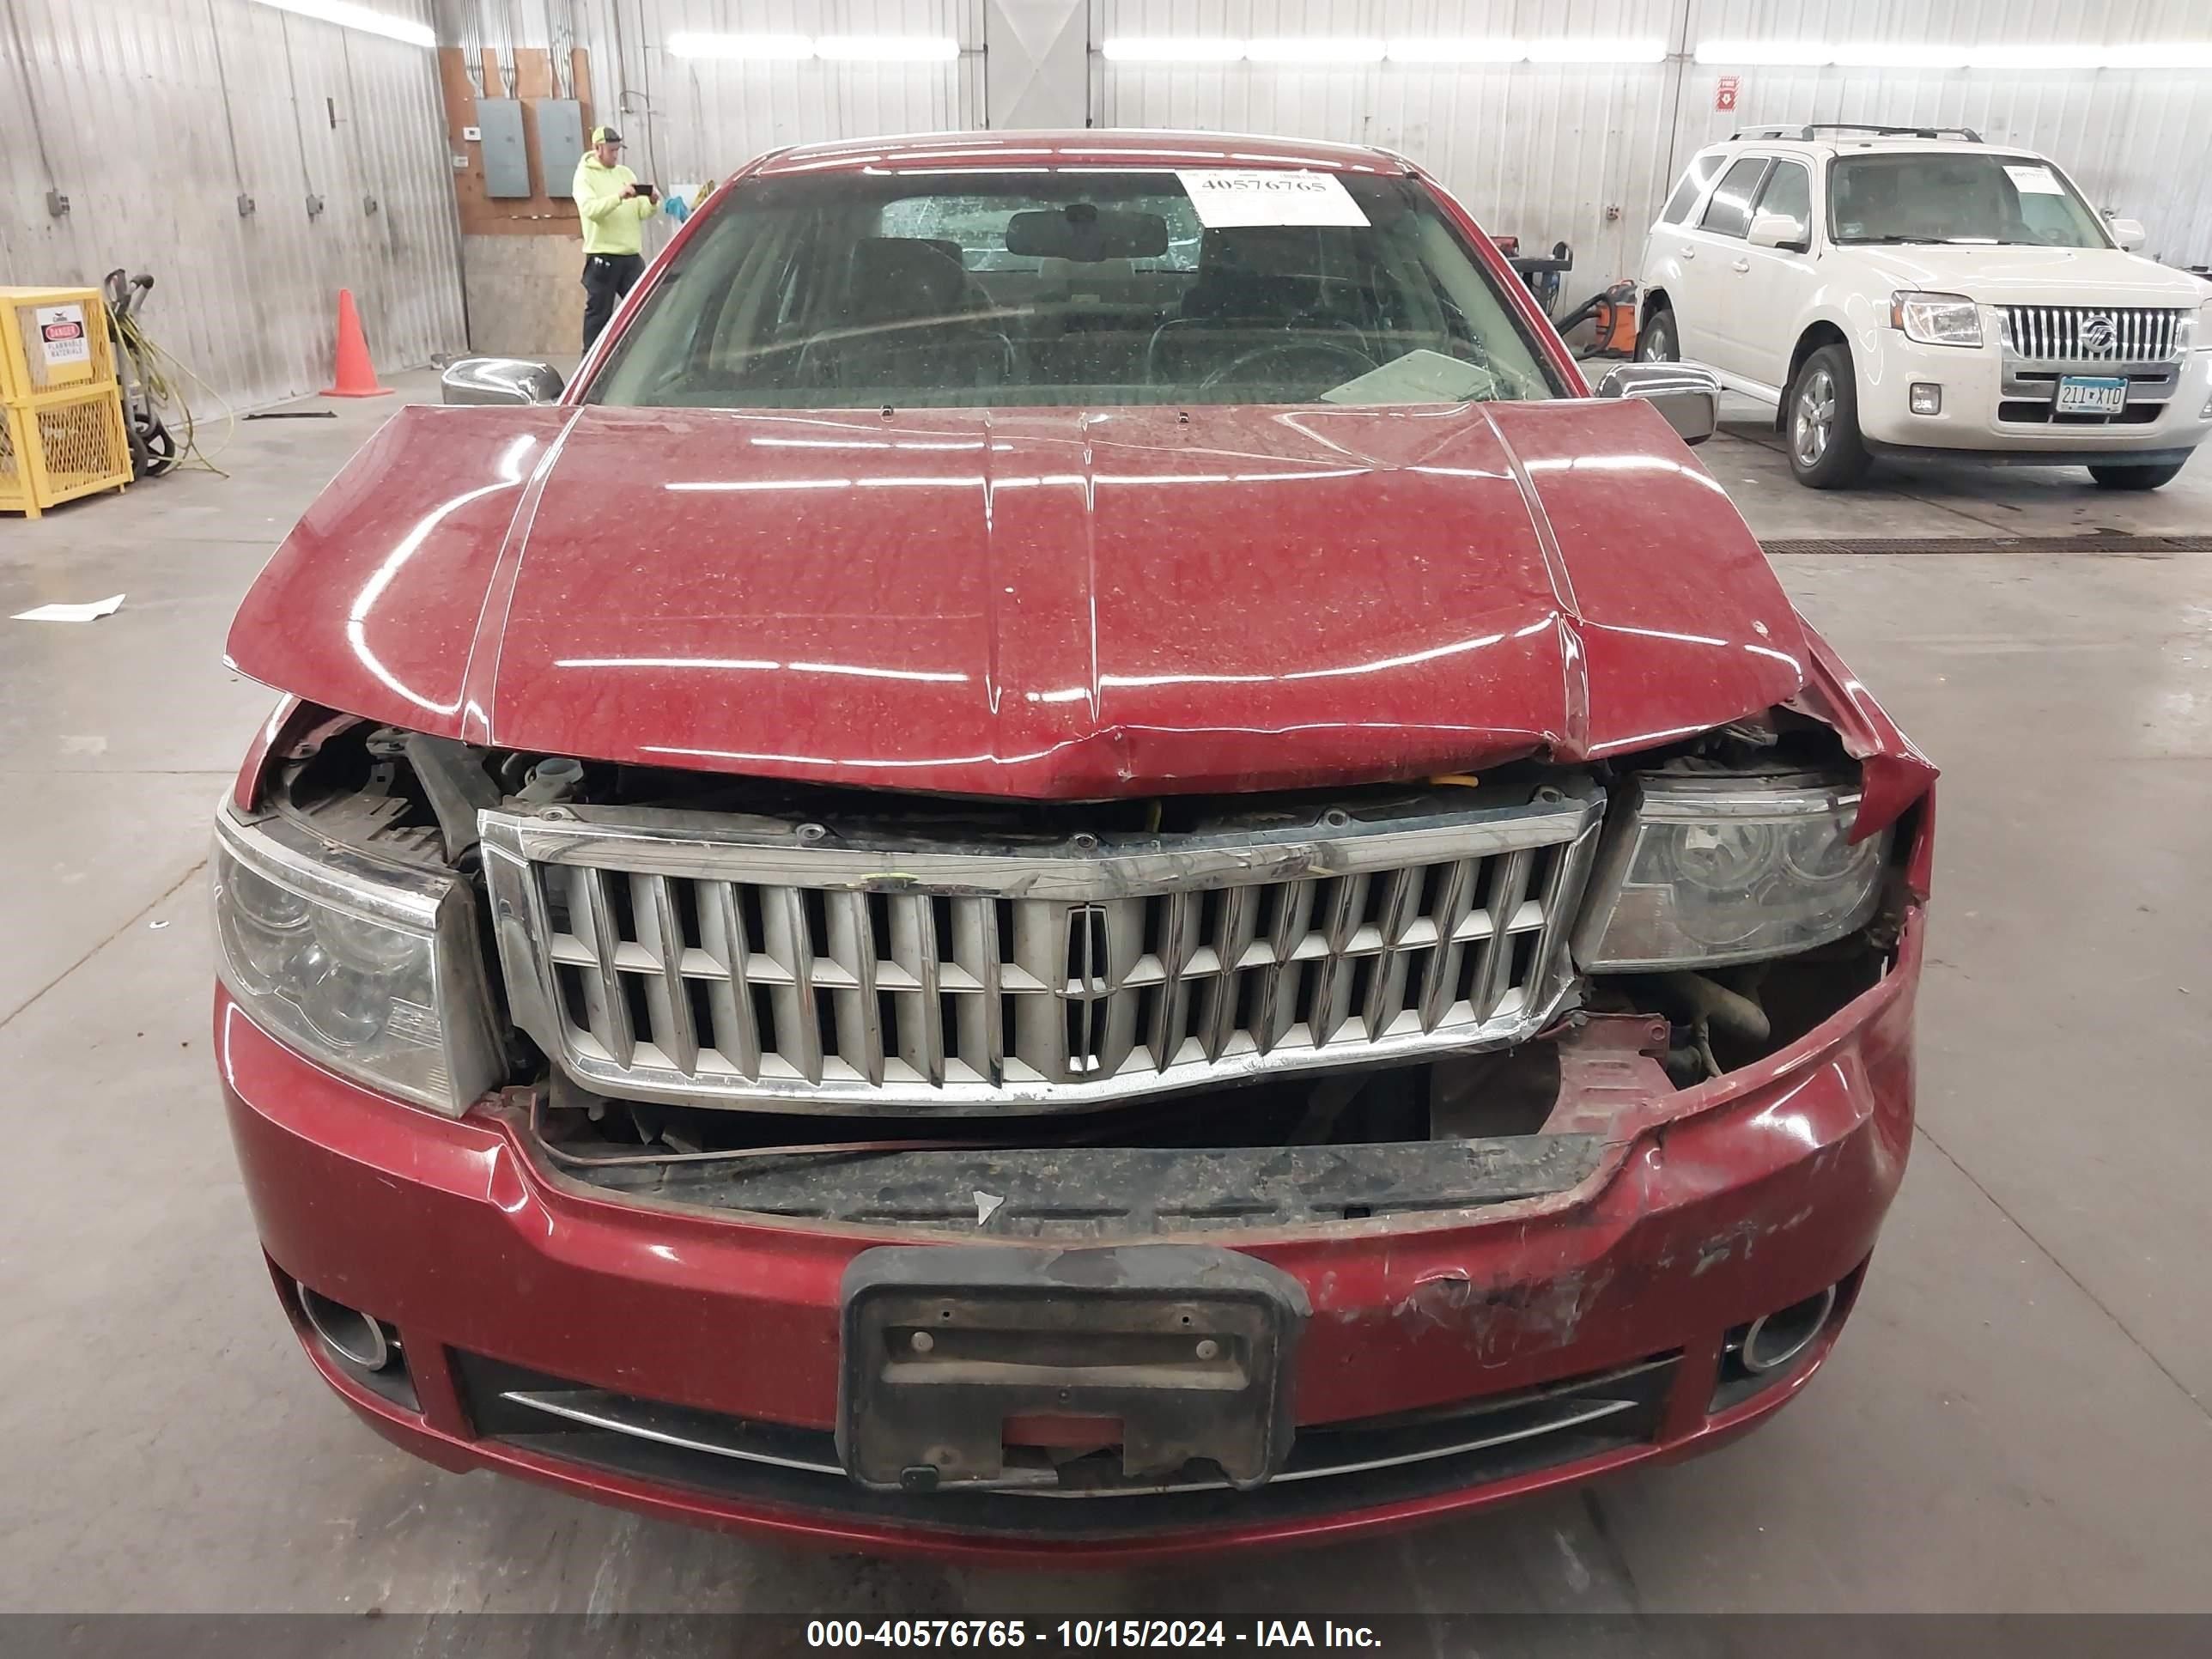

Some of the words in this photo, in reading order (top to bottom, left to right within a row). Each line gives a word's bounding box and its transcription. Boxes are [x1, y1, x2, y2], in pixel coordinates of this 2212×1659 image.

[1201, 179, 1328, 193] 40576765
[2062, 386, 2087, 404] 211
[2096, 387, 2123, 405] XTD
